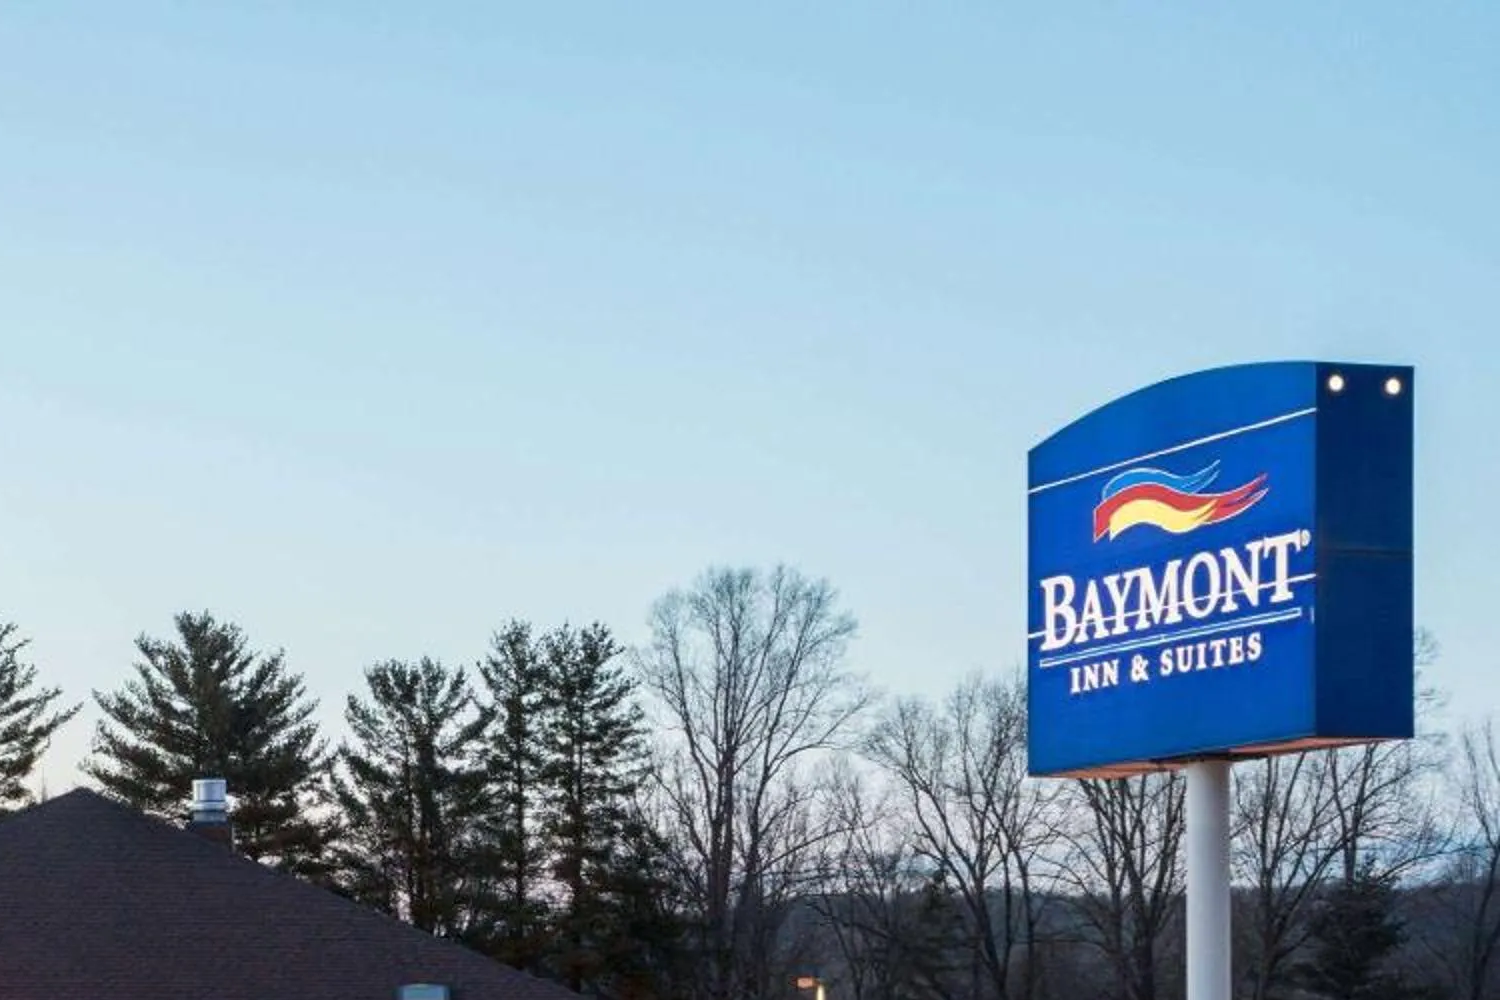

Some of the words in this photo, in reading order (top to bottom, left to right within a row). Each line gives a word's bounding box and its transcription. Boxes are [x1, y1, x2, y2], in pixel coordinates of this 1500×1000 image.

[1039, 529, 1303, 652] BAYMONT
[1070, 659, 1119, 695] INN
[1130, 654, 1149, 684] &
[1159, 632, 1263, 675] SUITES
